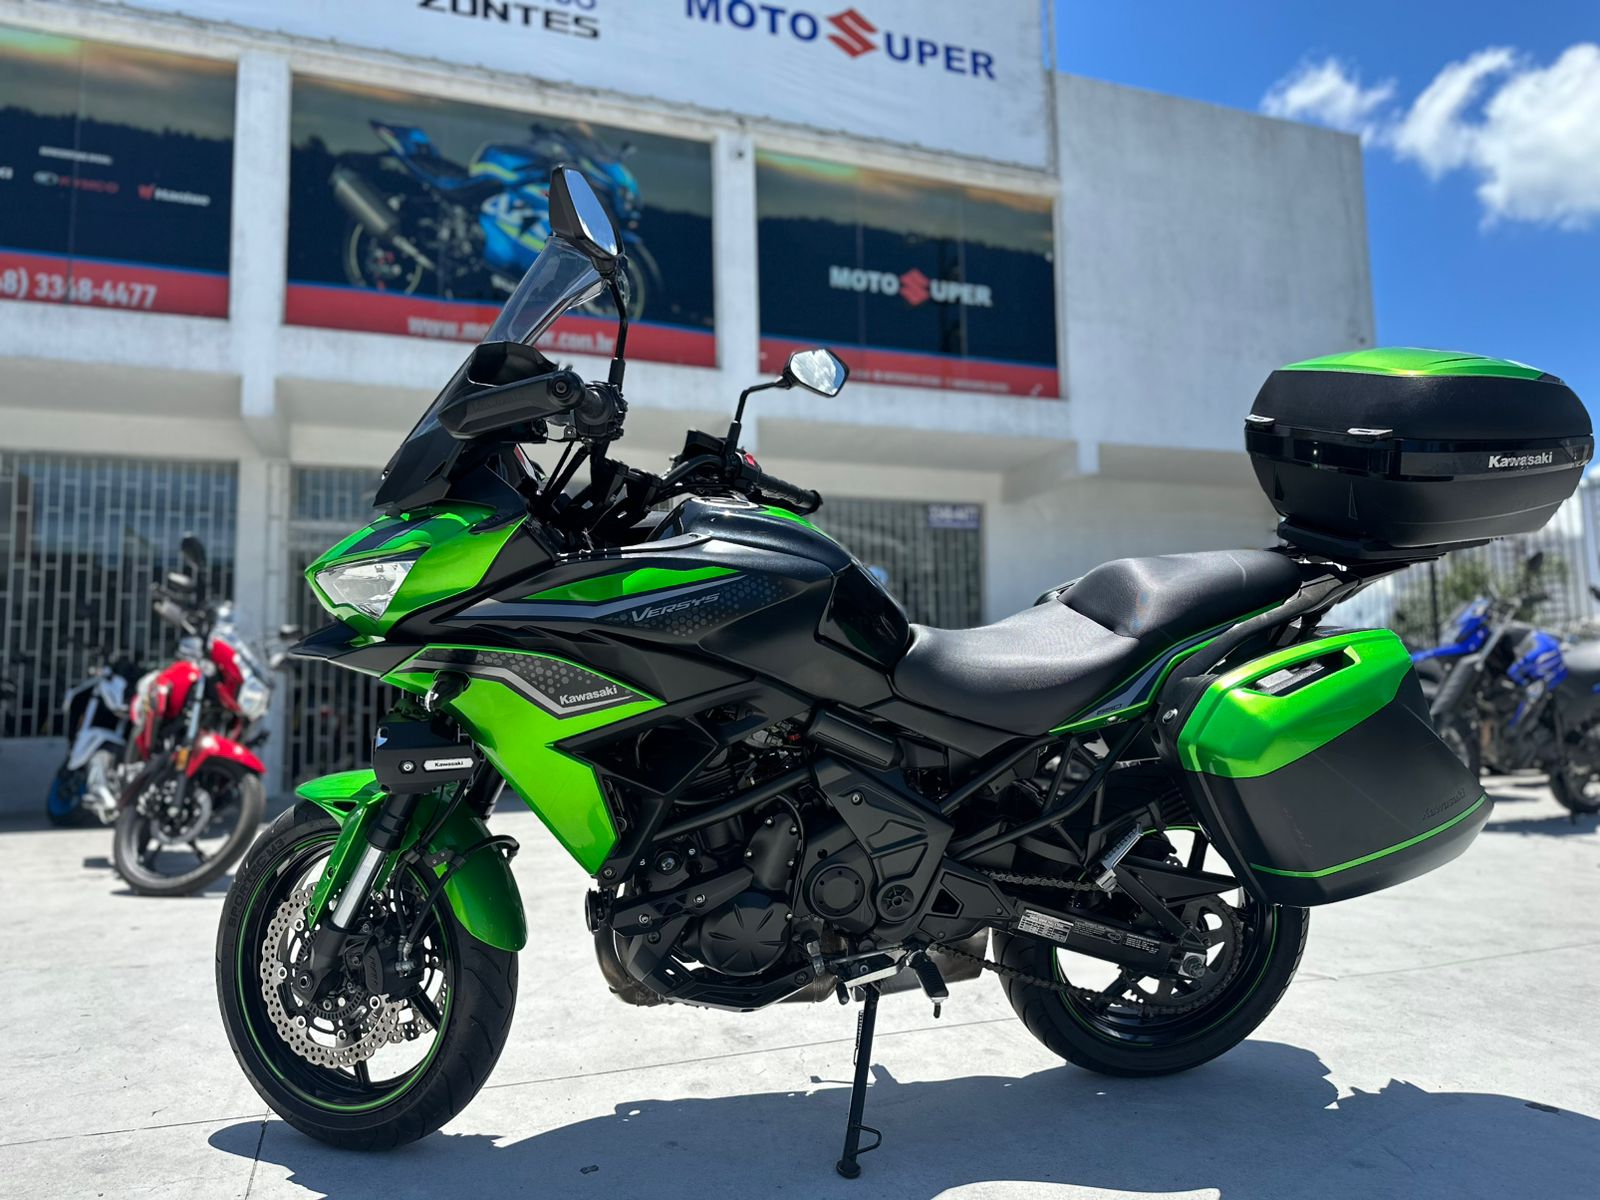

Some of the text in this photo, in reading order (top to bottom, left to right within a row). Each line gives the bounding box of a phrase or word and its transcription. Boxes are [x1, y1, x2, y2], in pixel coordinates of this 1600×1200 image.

[0, 267, 29, 300] 8)
[1488, 452, 1553, 468] Kawasaki
[559, 685, 618, 705] Kawasaki
